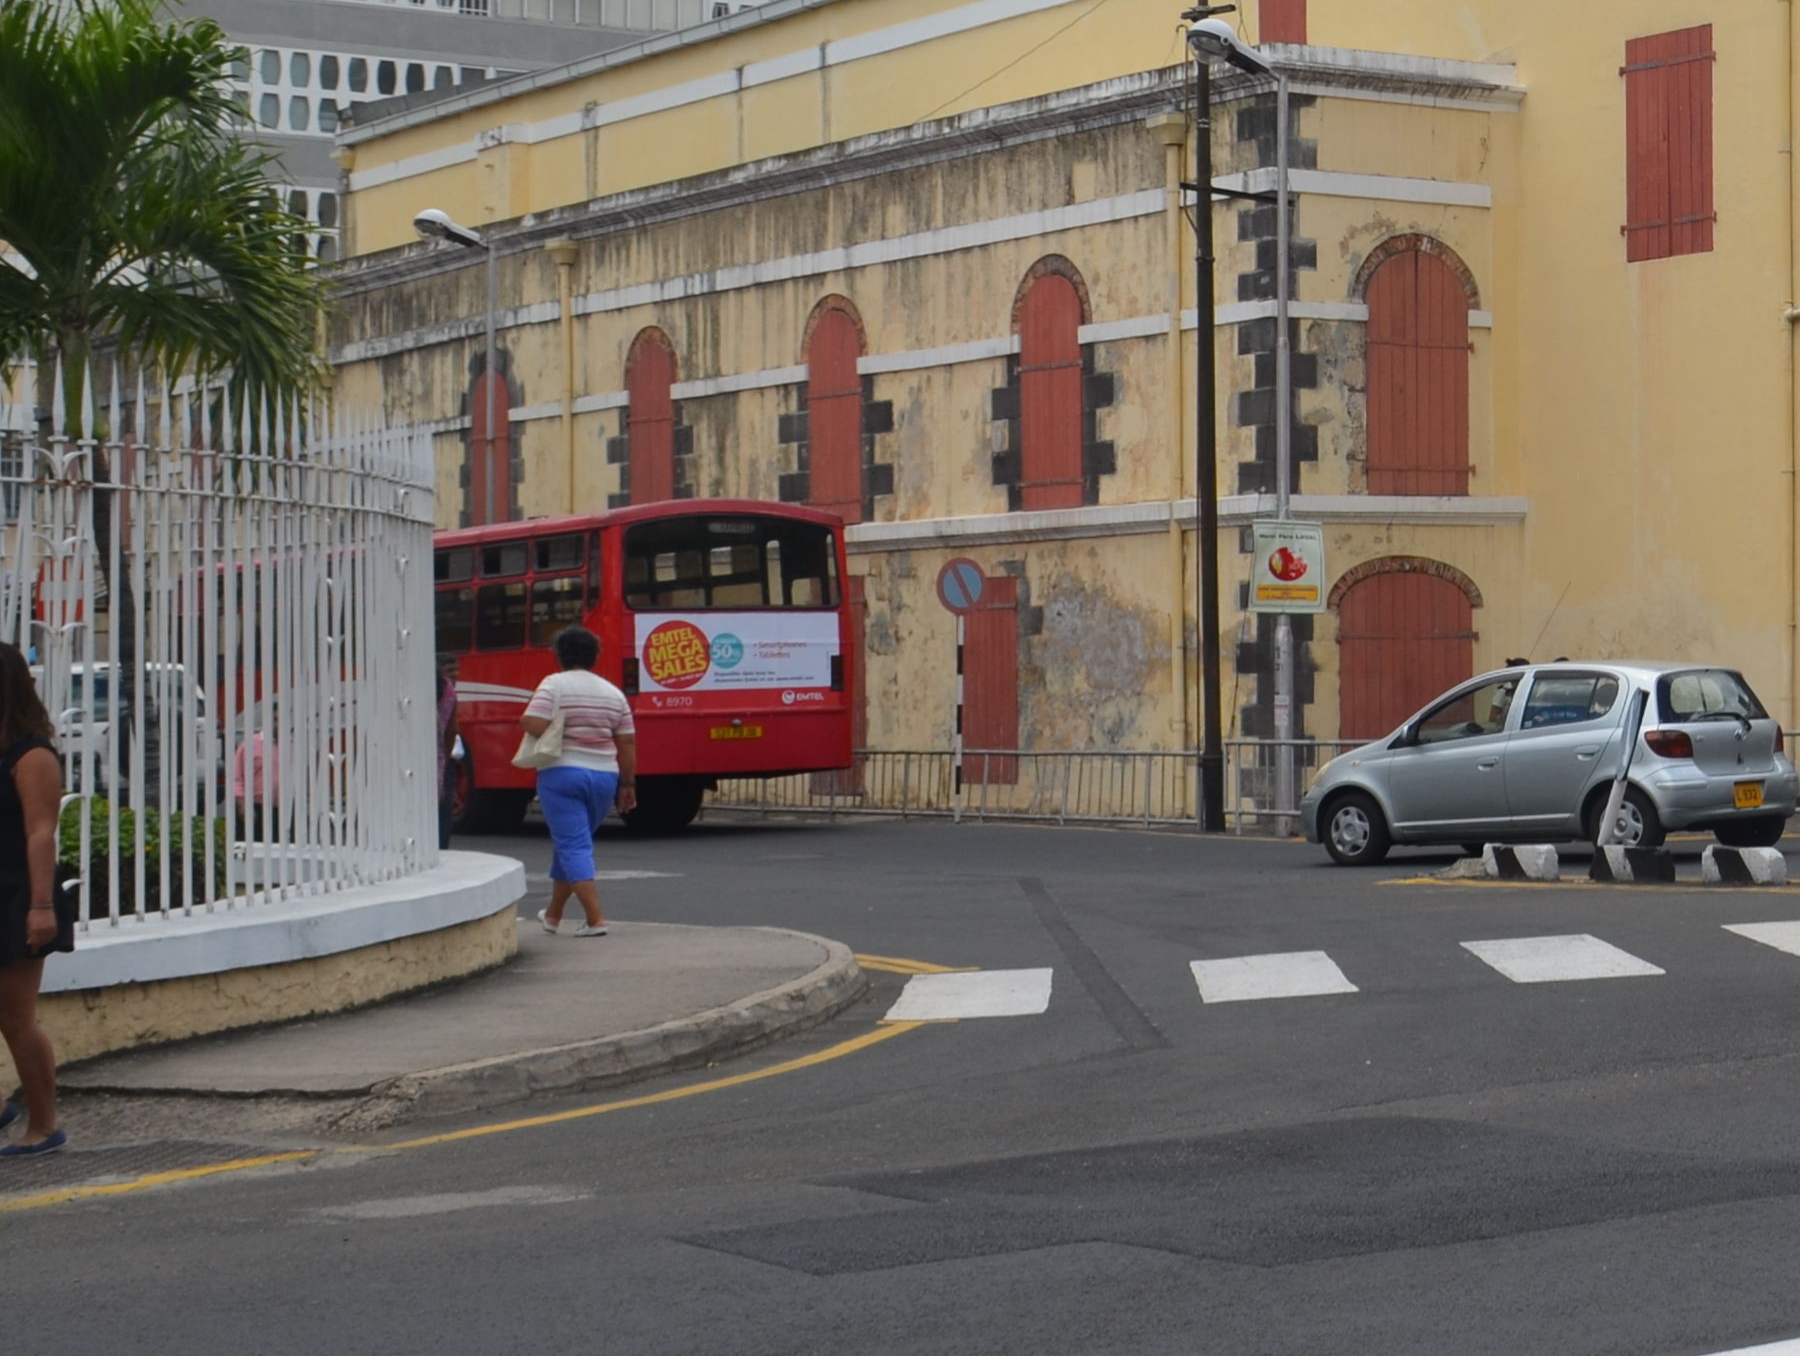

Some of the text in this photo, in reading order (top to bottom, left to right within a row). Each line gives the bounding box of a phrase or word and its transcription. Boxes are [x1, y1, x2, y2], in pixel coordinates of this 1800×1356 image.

[651, 627, 696, 646] EMTEL
[649, 639, 704, 663] MEGA
[651, 654, 707, 680] SALES
[666, 696, 693, 707] 8970
[796, 692, 825, 701] EMTEL
